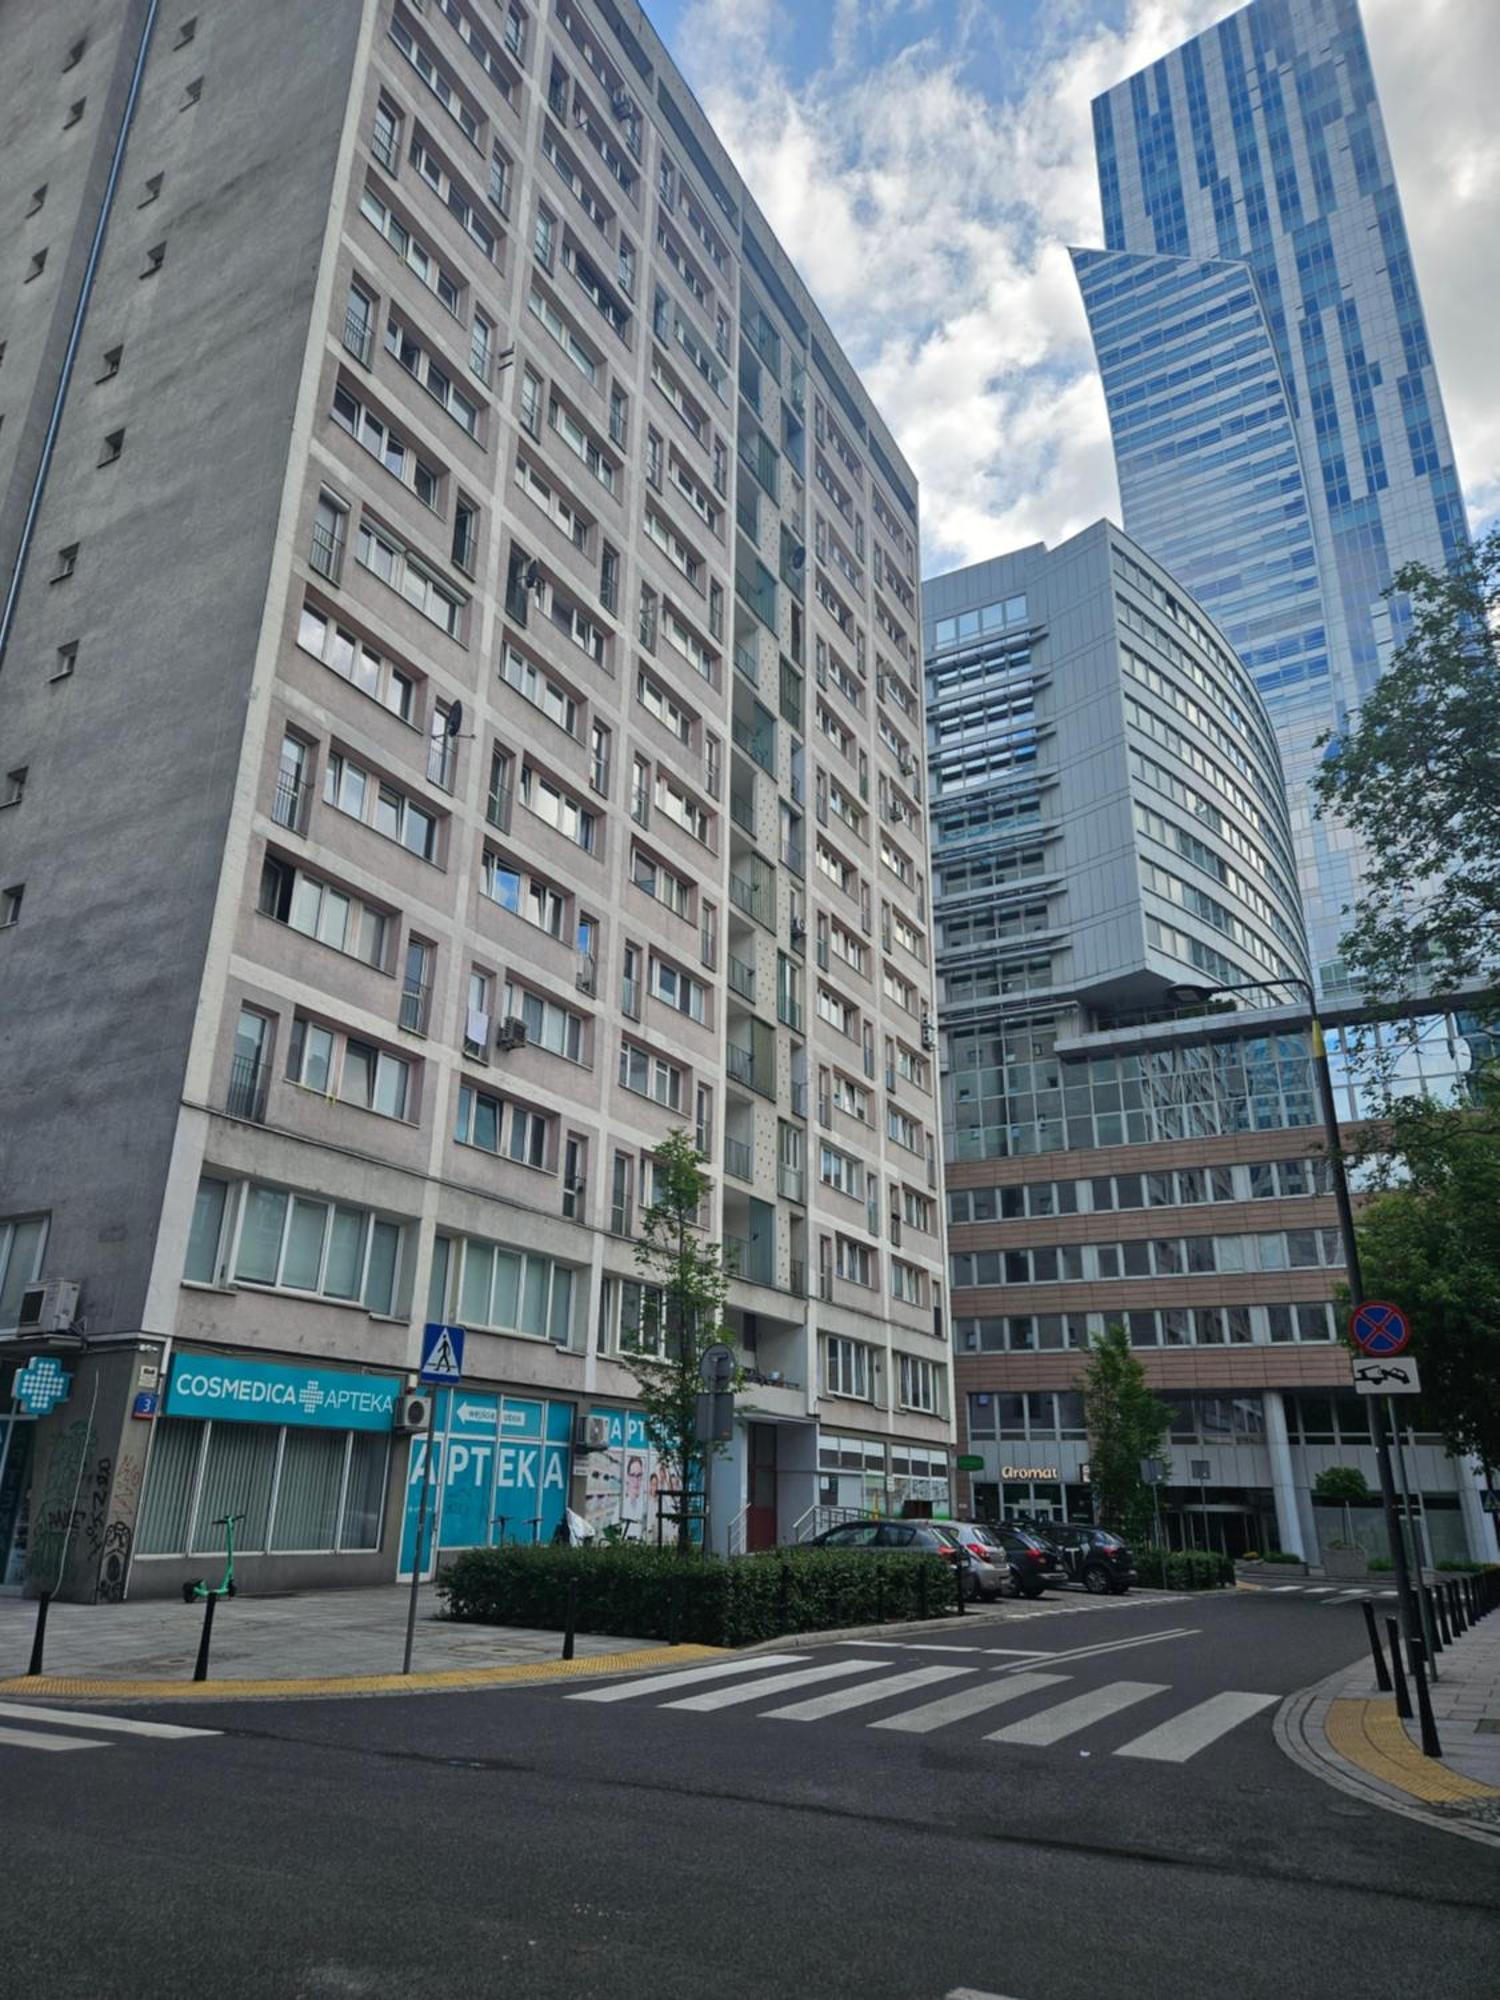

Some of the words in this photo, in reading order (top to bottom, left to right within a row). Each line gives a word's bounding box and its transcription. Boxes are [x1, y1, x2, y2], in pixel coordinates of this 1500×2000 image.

[143, 1398, 152, 1412] 3
[176, 1373, 296, 1405] COSMEDICA
[324, 1389, 394, 1414] APTEKA
[409, 1442, 564, 1489] APTEKA
